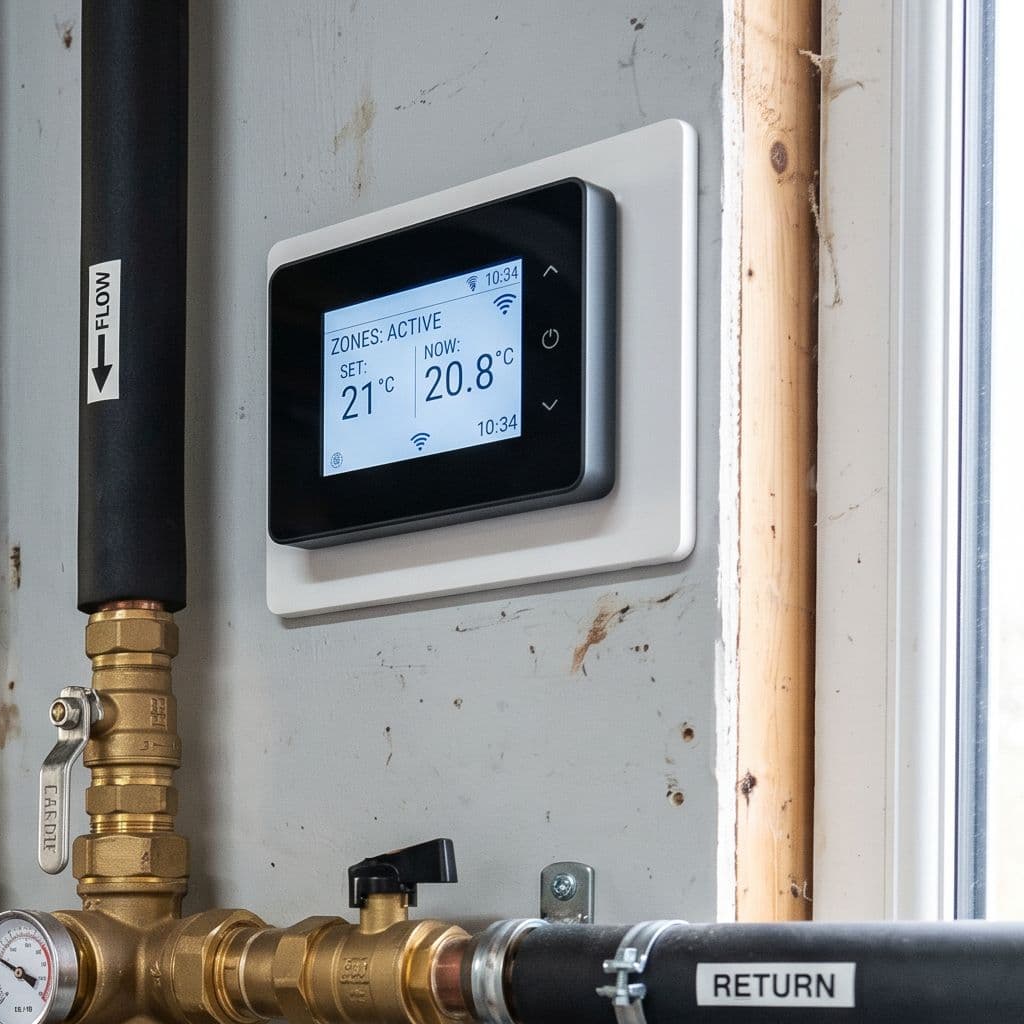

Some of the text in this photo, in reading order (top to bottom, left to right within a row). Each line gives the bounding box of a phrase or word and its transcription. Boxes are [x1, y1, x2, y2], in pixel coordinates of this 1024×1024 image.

[485, 265, 519, 287] 10:34
[95, 271, 111, 331] FLOW
[330, 311, 442, 356] ZONES: ACTIVE
[424, 338, 461, 360] NOW:
[339, 360, 367, 379] SET:
[476, 413, 518, 437] 10:34
[713, 973, 836, 998] RETURN
